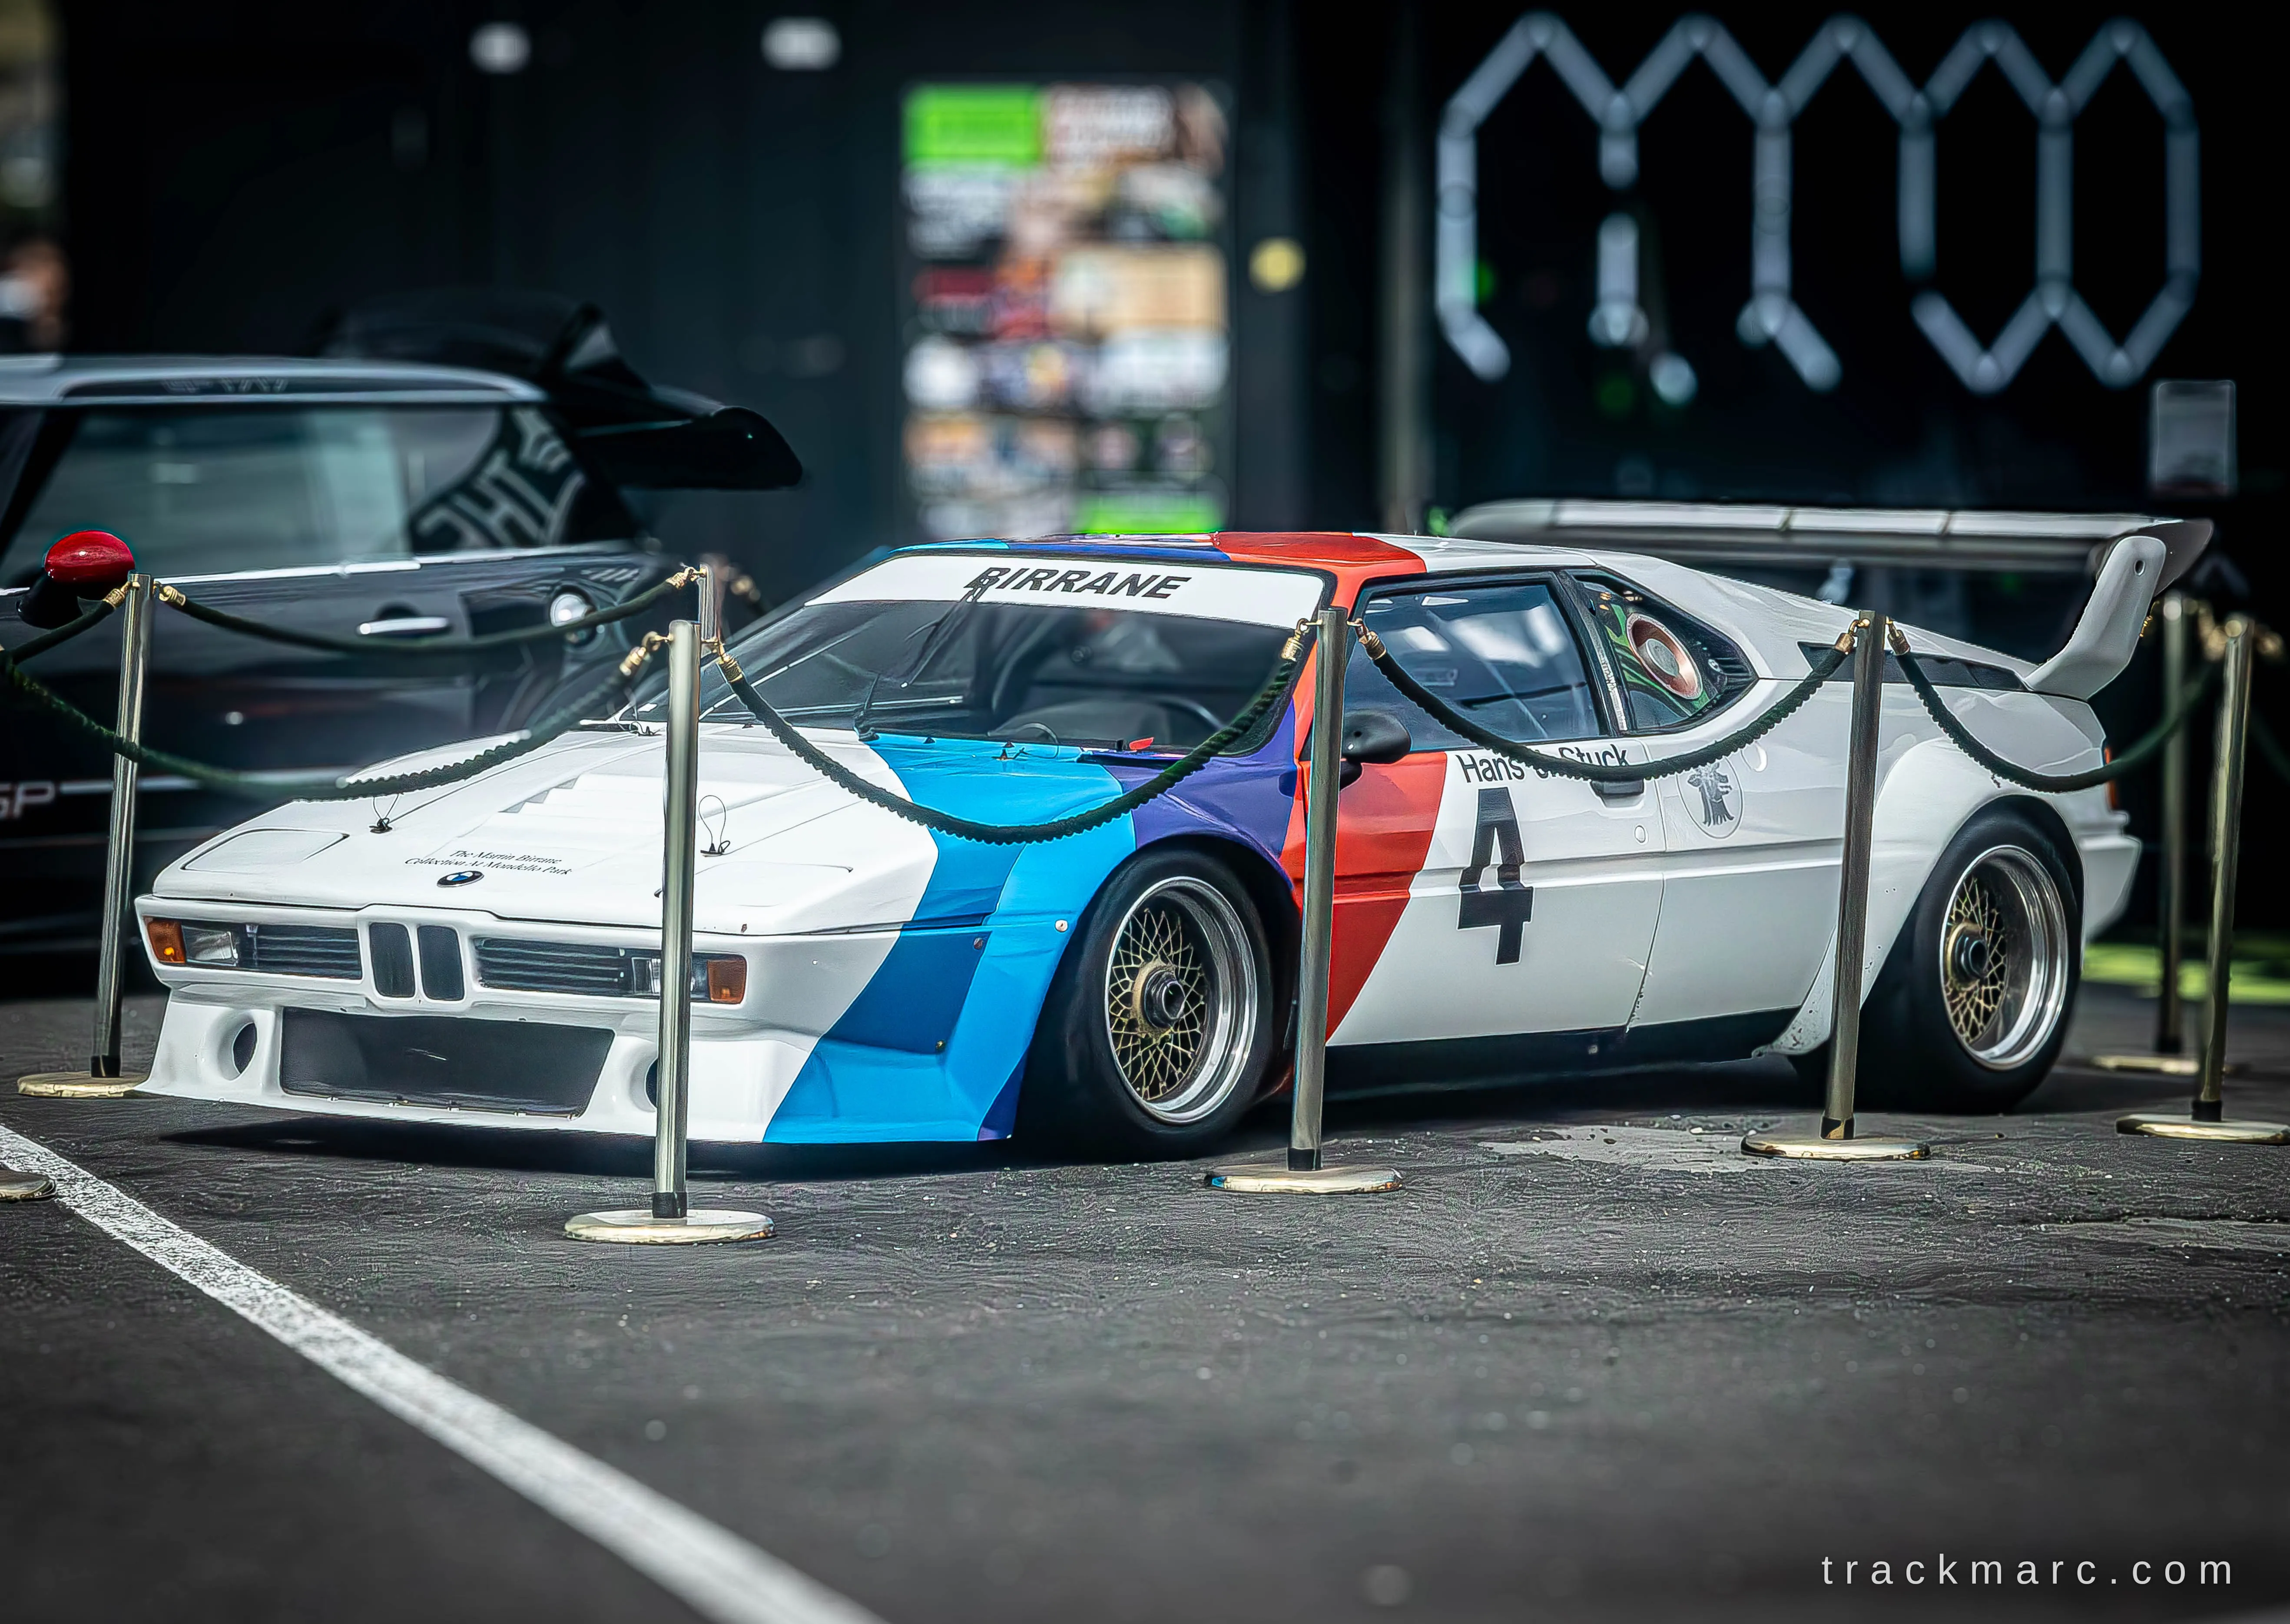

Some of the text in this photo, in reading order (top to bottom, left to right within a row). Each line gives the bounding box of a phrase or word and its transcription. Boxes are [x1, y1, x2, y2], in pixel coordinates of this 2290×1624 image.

[964, 567, 1192, 599] BIRRANE
[1456, 754, 1524, 783] Hans
[473, 852, 515, 860] Martin
[515, 855, 562, 864] Birrane
[483, 862, 541, 871] Mondello
[542, 867, 572, 875] Park
[1457, 787, 1534, 966] 4
